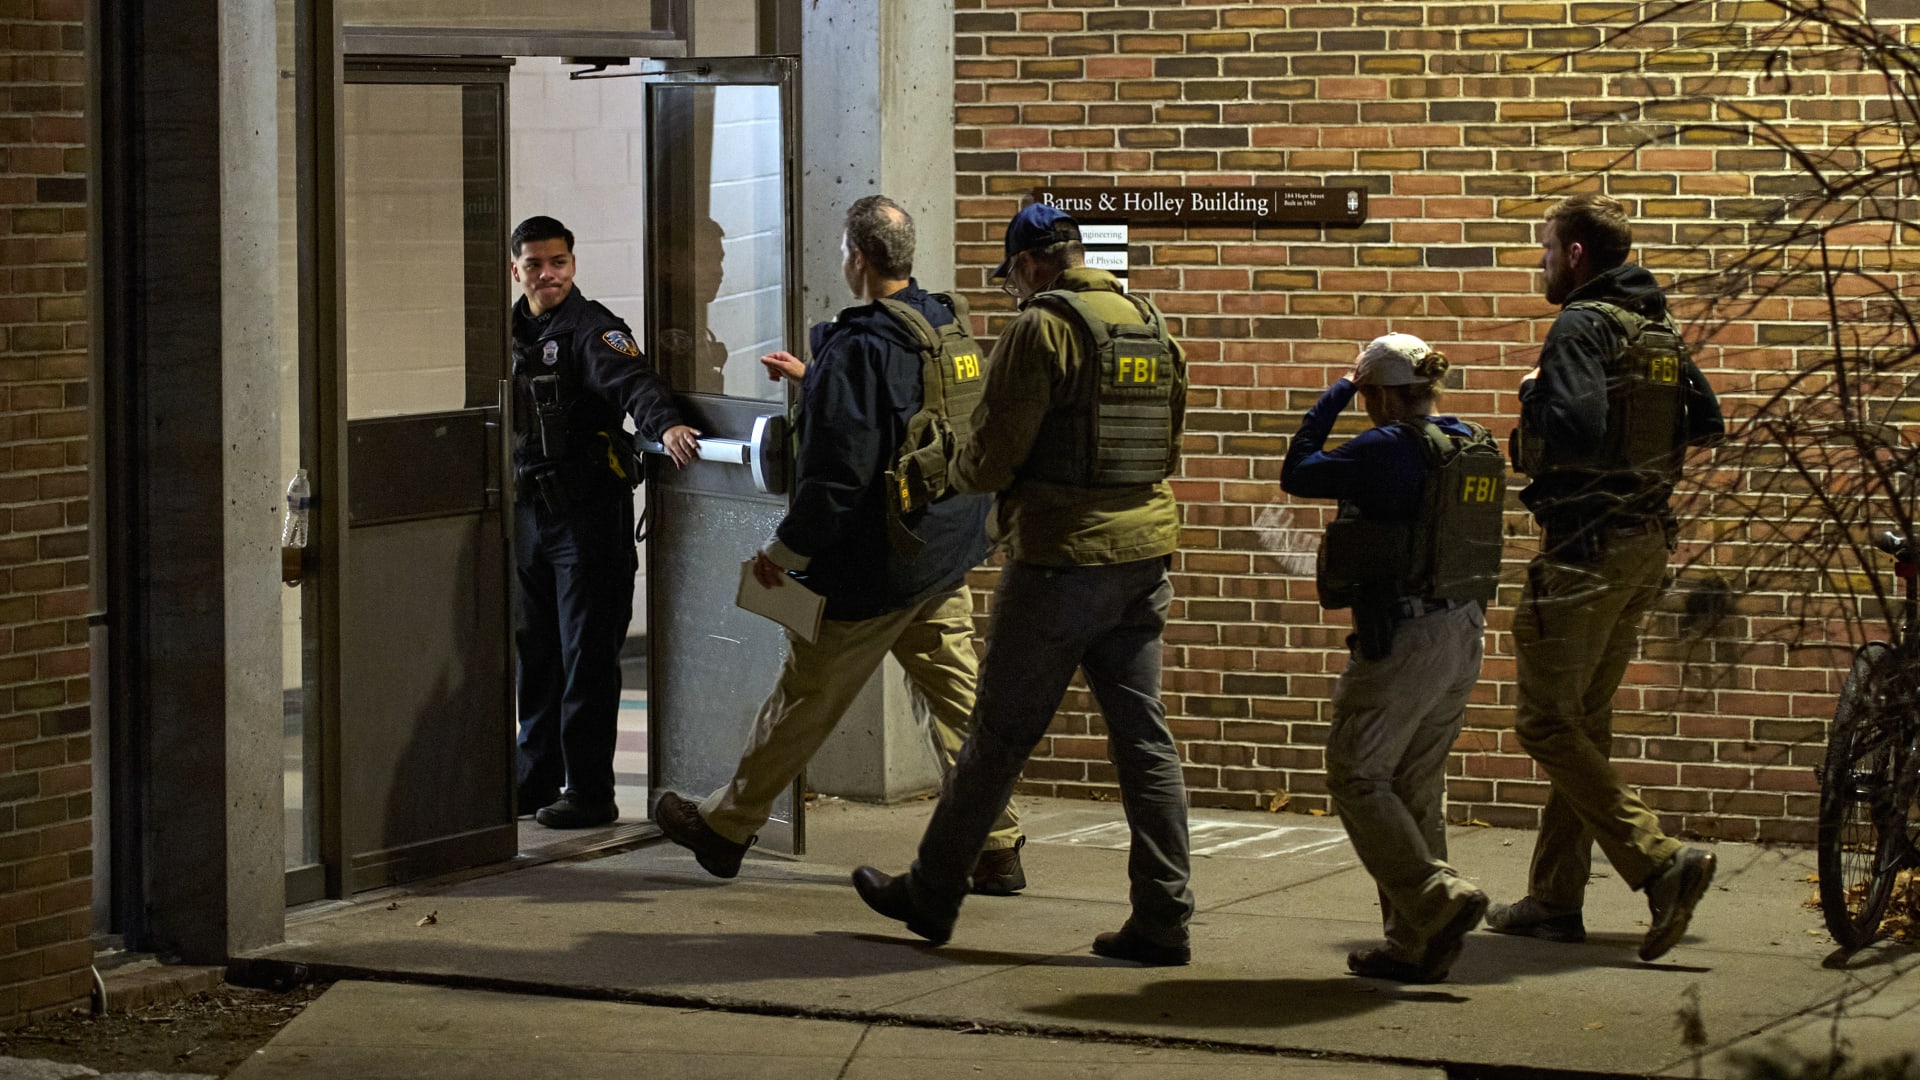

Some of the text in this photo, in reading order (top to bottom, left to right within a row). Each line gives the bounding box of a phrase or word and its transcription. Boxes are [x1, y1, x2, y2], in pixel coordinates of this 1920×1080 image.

[1042, 191, 1269, 216] Barus & Holley Building
[1295, 192, 1309, 200] Hope
[1081, 230, 1122, 240] ngineering
[1086, 255, 1123, 267] of Physics
[954, 353, 980, 380] FBI
[1118, 356, 1157, 383] FBI
[1651, 356, 1679, 383] FBI
[900, 478, 911, 511] FBI
[1463, 475, 1498, 503] FBI
